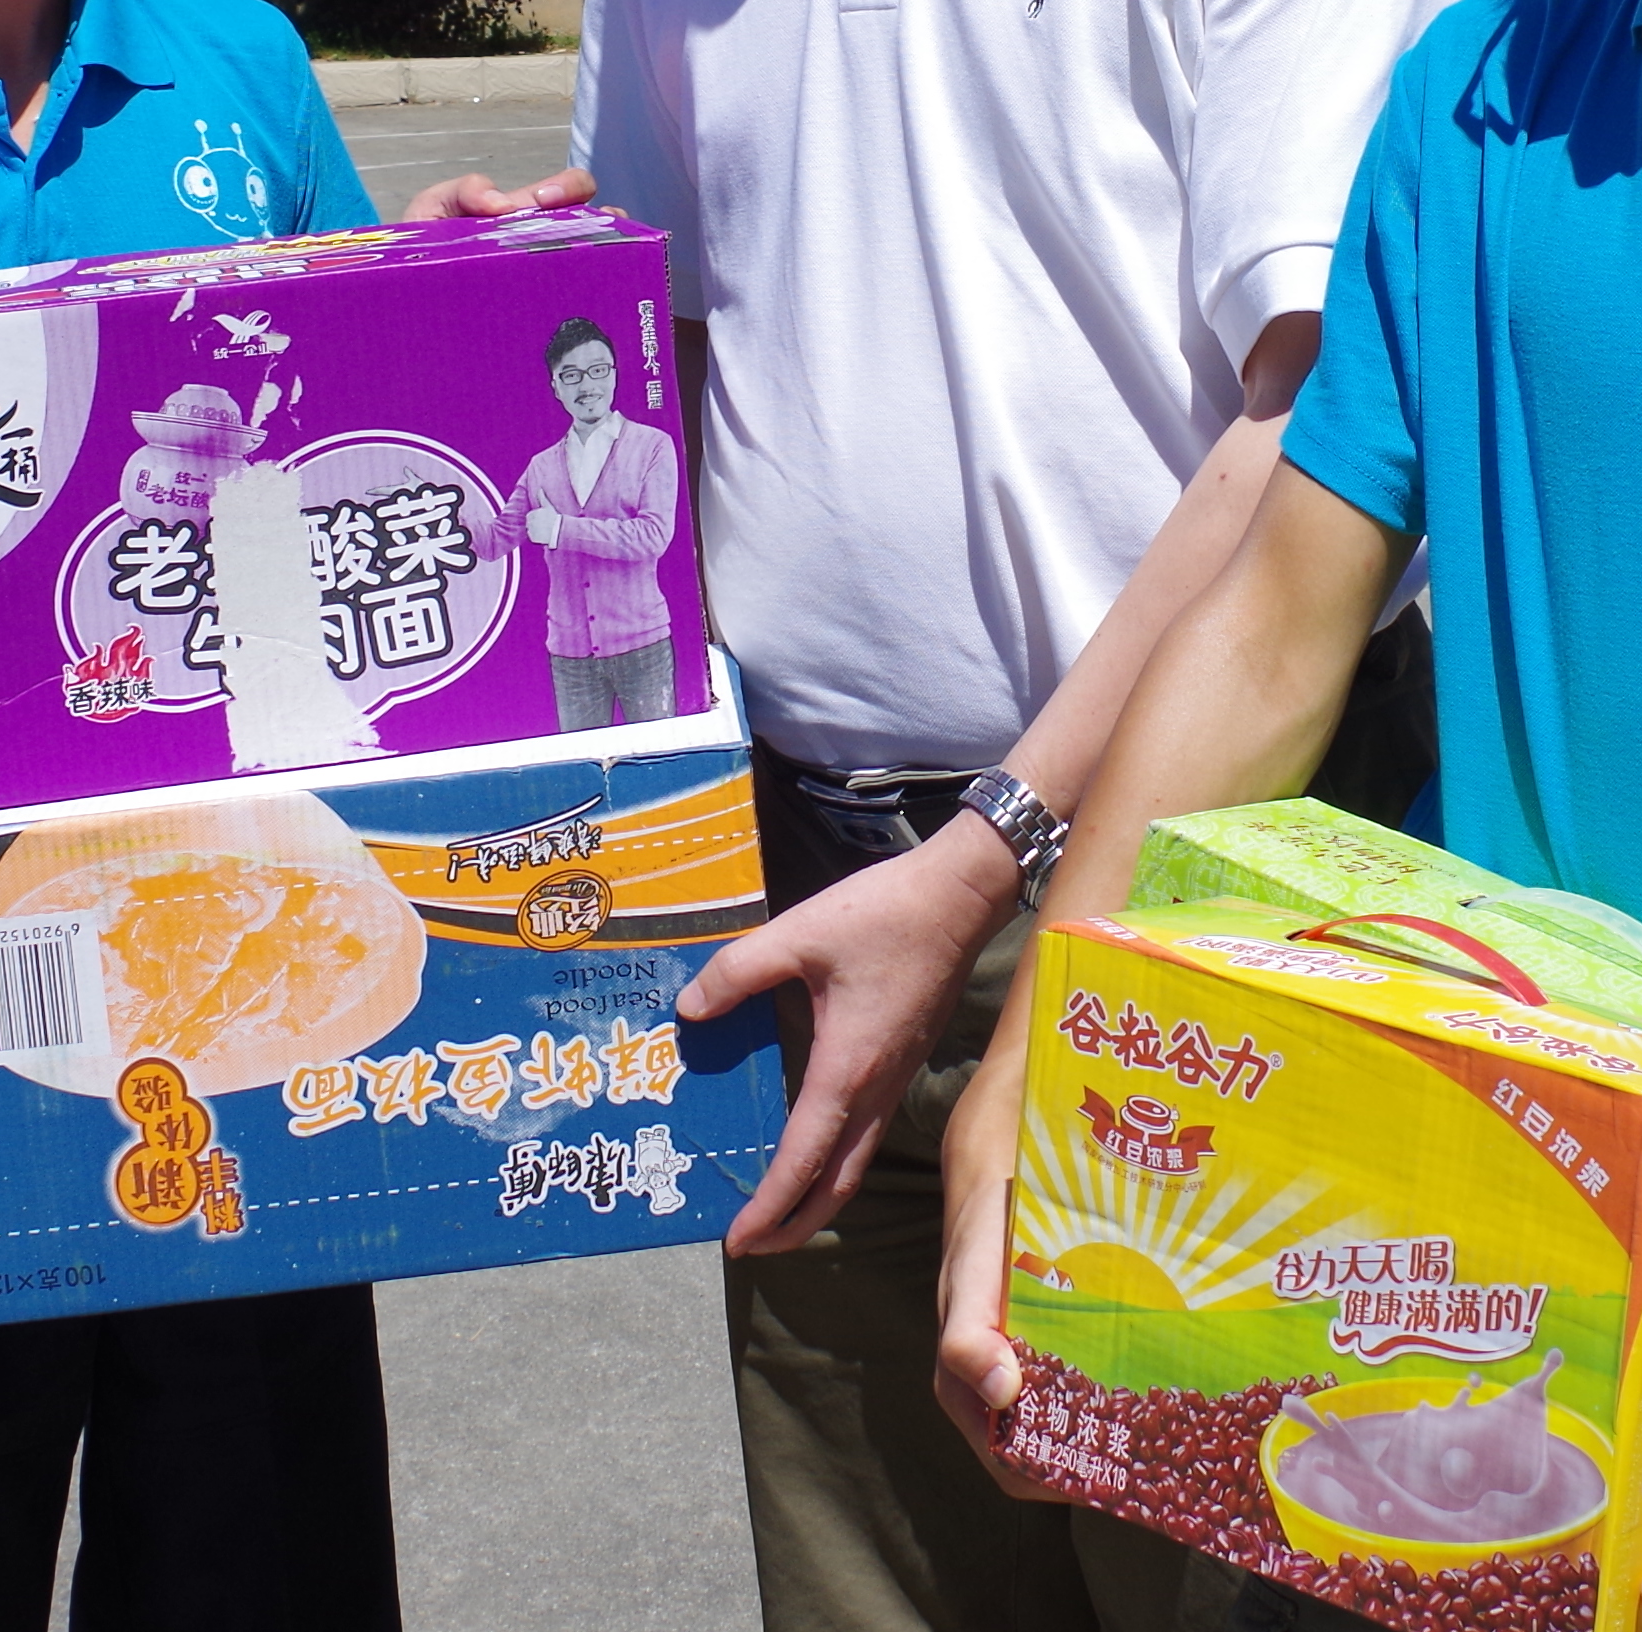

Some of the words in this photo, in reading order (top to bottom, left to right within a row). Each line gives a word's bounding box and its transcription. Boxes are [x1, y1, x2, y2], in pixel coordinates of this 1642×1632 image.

[113, 488, 472, 609] 老酸菜
[69, 678, 157, 714] 香辣味
[528, 894, 600, 940] 经典
[552, 959, 657, 988] Noodle
[544, 988, 661, 1022] Seafood
[1059, 991, 1270, 1100] 谷粒谷力
[289, 1020, 683, 1133] 鲜虾鱼板面
[131, 1074, 194, 1214] 新体验
[1104, 1129, 1185, 1169] 红豆浓浆
[1491, 1077, 1611, 1198] 红豆浓浆
[1275, 1240, 1449, 1292] 谷力天天喝
[1344, 1287, 1545, 1334] 健康满满的!
[1018, 1386, 1132, 1459] 谷物浓浆
